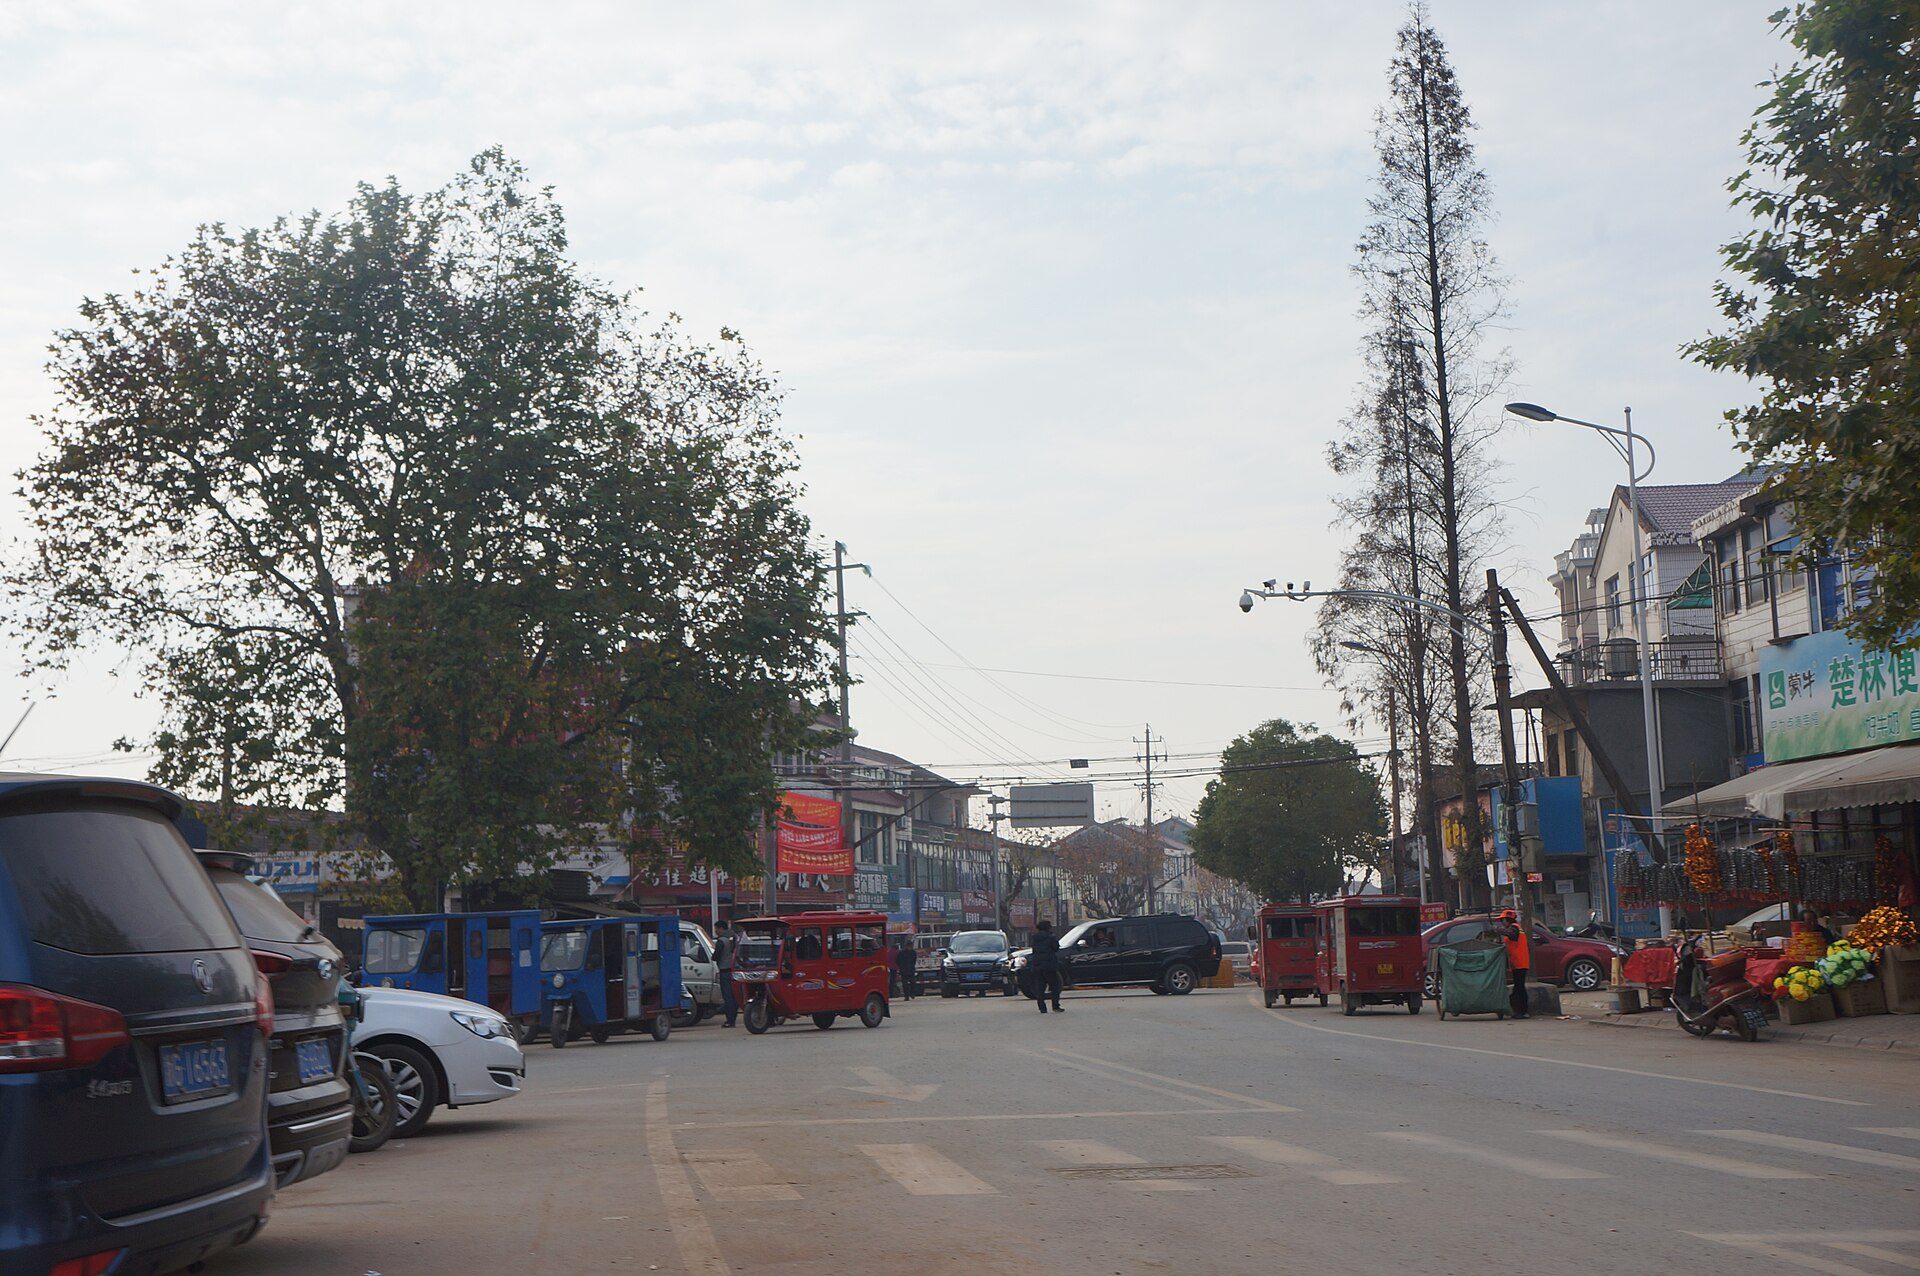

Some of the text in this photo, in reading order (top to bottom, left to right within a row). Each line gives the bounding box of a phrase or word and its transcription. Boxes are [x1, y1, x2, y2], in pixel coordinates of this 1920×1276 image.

[1788, 669, 1816, 700] 蒙牛
[1829, 648, 1919, 709] 楚林便
